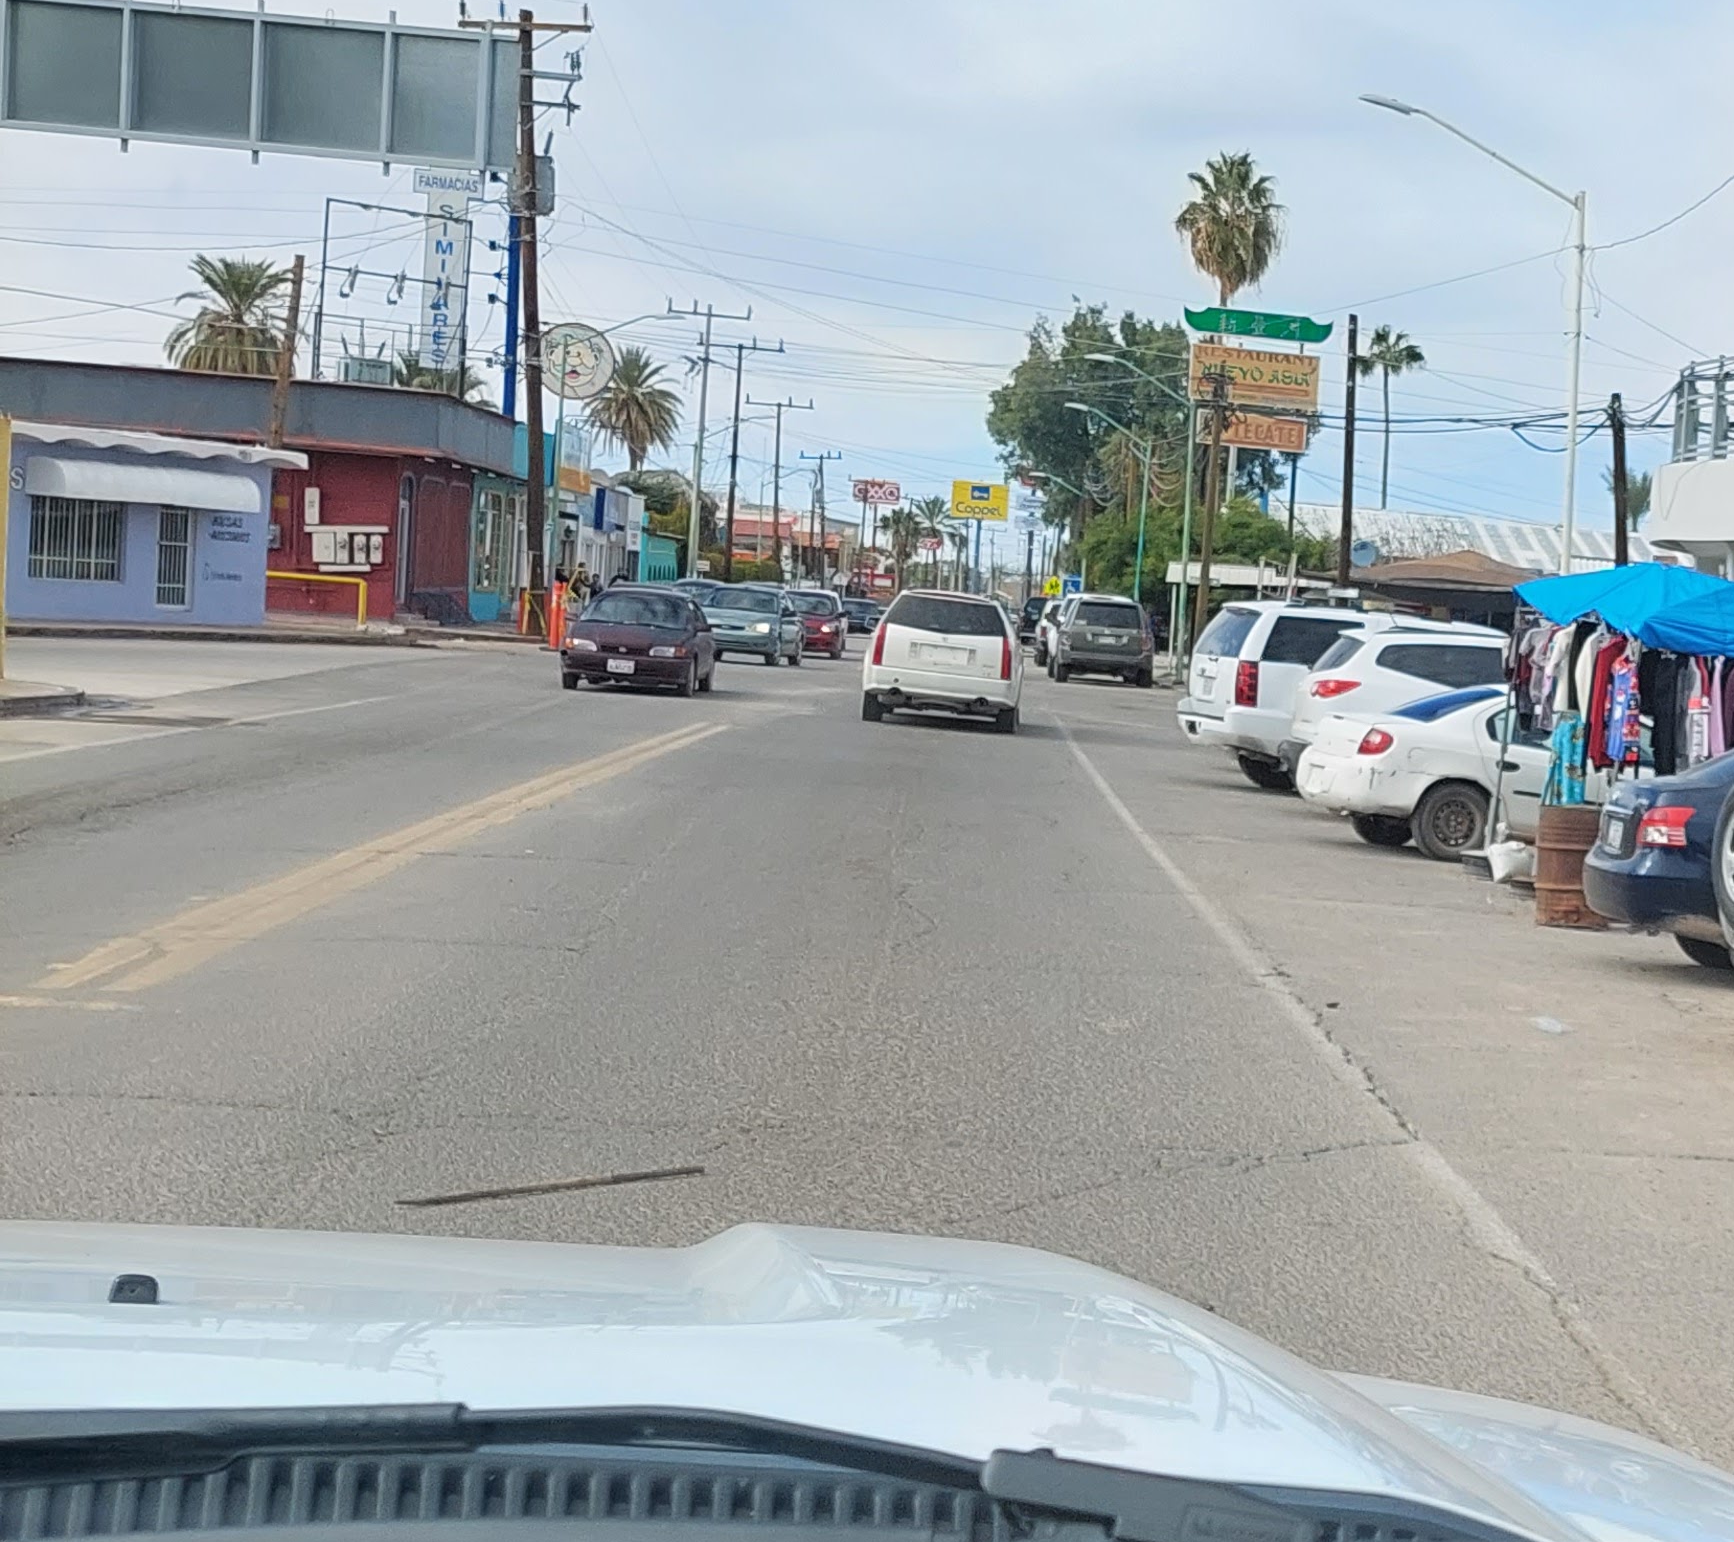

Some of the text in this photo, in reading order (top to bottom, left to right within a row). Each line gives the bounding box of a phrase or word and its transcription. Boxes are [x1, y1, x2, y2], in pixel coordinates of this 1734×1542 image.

[418, 174, 479, 194] FARMACIAS
[1195, 346, 1317, 369] RESTAURANT
[1267, 370, 1310, 387] ASIA
[1233, 421, 1298, 444] TECATE
[854, 484, 899, 501] OXXO
[955, 501, 1003, 519] Coppel
